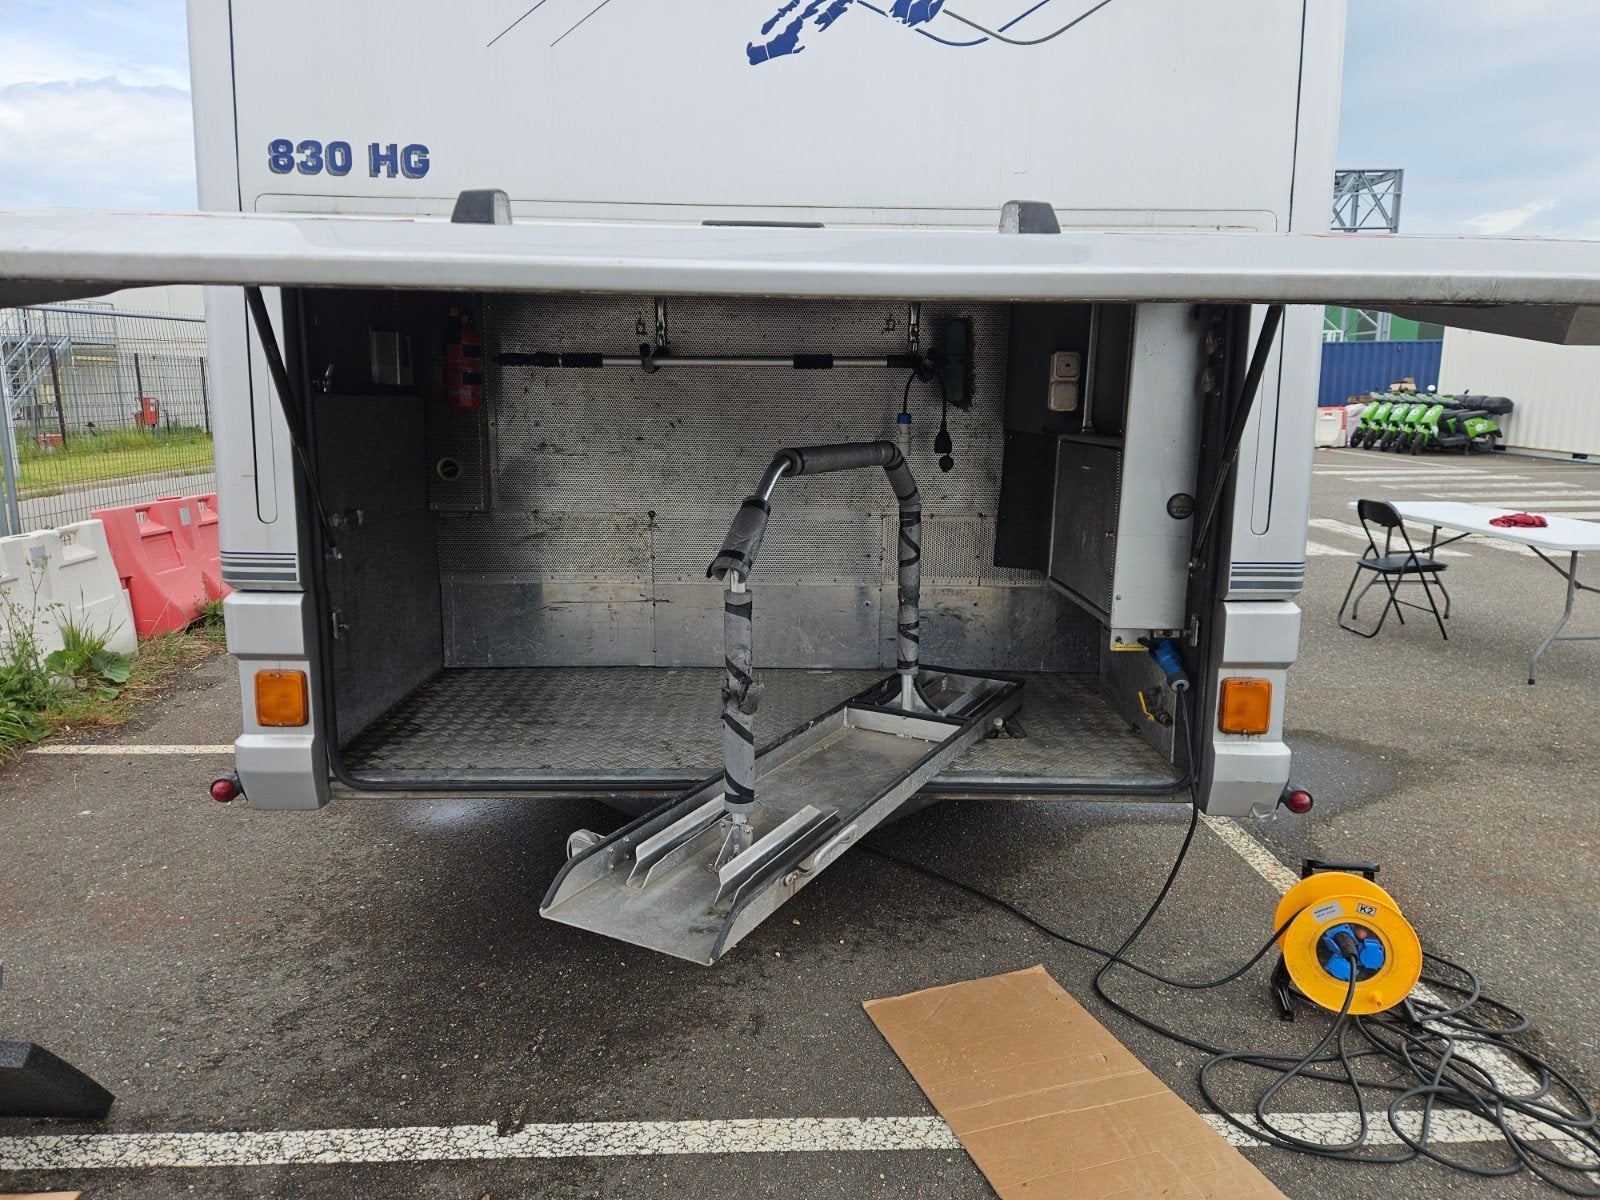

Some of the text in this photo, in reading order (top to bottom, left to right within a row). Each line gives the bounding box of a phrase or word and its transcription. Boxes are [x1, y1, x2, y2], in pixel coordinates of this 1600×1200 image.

[268, 138, 430, 179] 830 HG
[1359, 905, 1374, 915] K2
